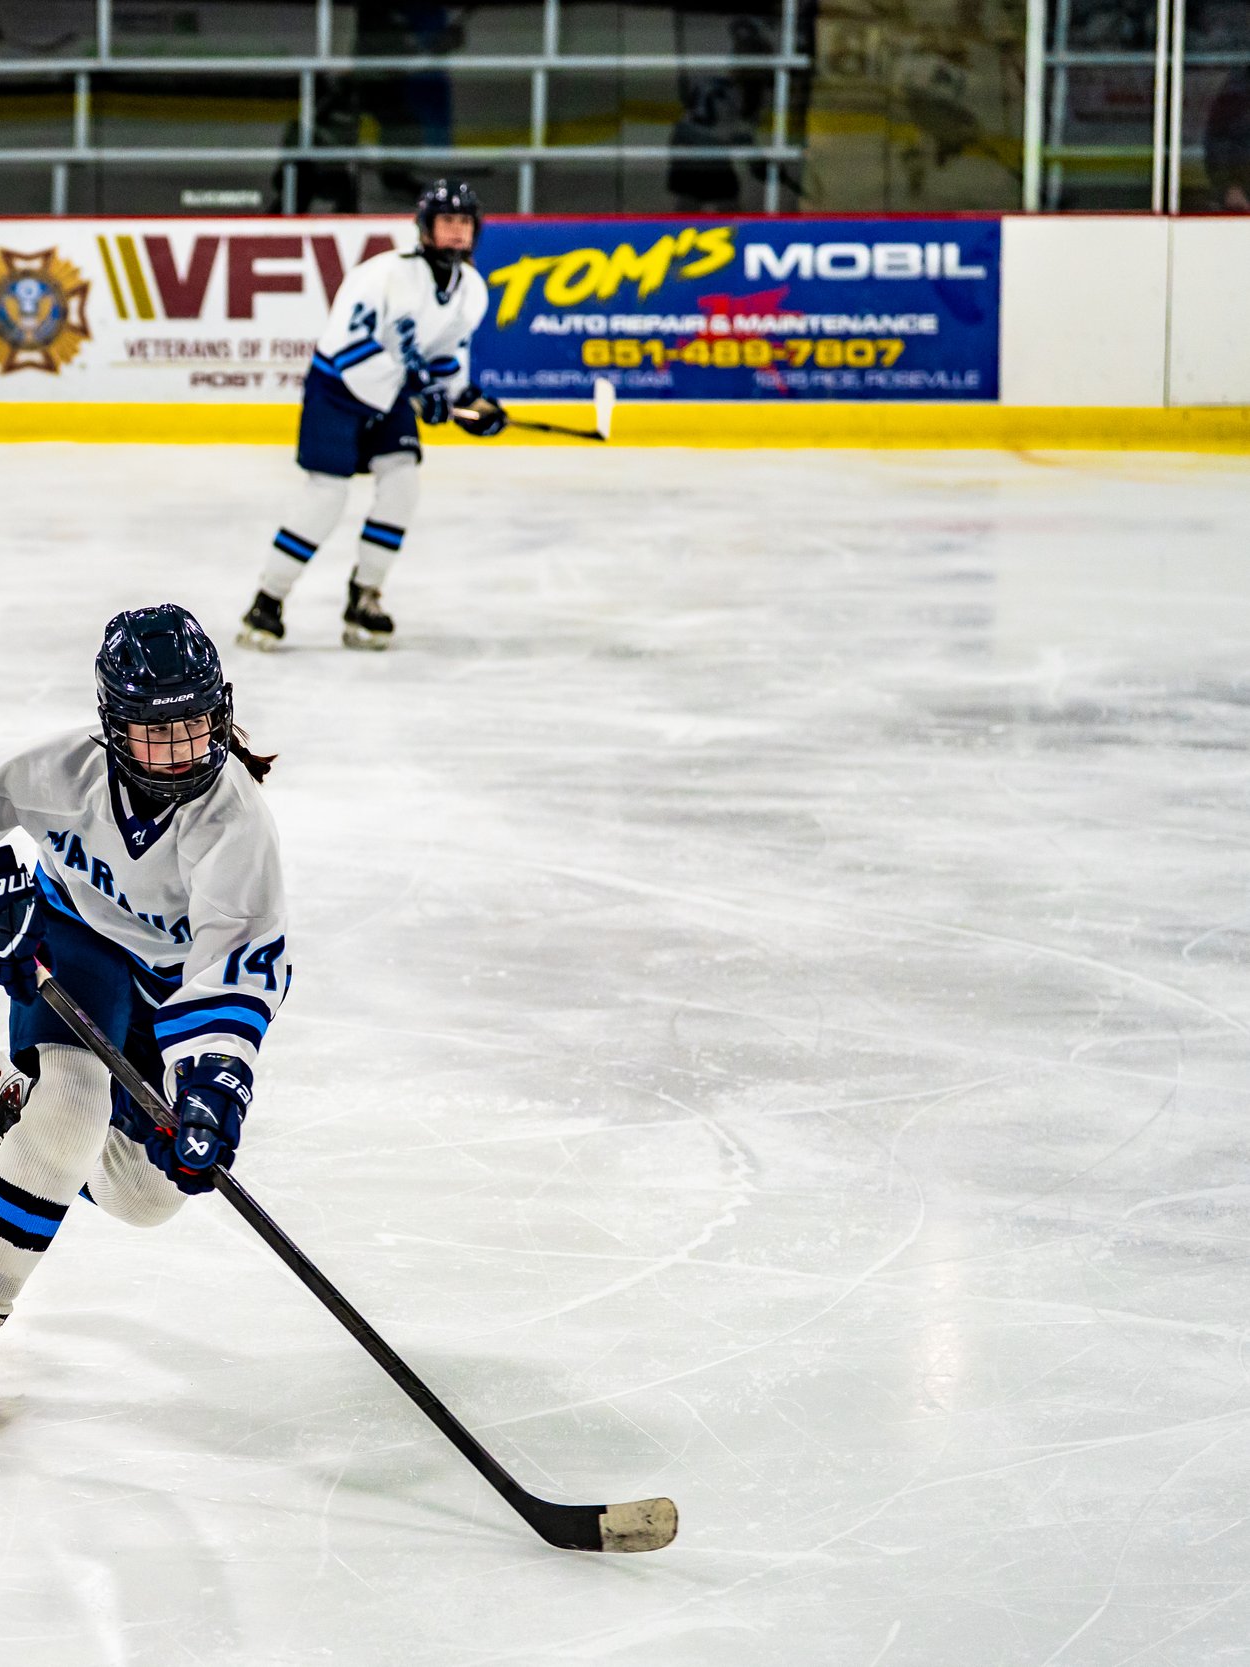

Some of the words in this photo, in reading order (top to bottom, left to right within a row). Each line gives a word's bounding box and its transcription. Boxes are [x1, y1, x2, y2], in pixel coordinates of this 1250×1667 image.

[143, 234, 398, 321] VFW
[488, 226, 738, 328] TOM'S
[744, 243, 987, 280] MOBIL
[530, 313, 607, 335] AUTO
[609, 313, 707, 335] REPAIR
[710, 313, 731, 335] &
[733, 313, 938, 335] MAINTENANCE
[125, 339, 232, 360] VETERANS
[239, 340, 263, 360] OF
[190, 372, 264, 388] POST
[152, 691, 195, 706] BAUER
[223, 934, 286, 992] 14
